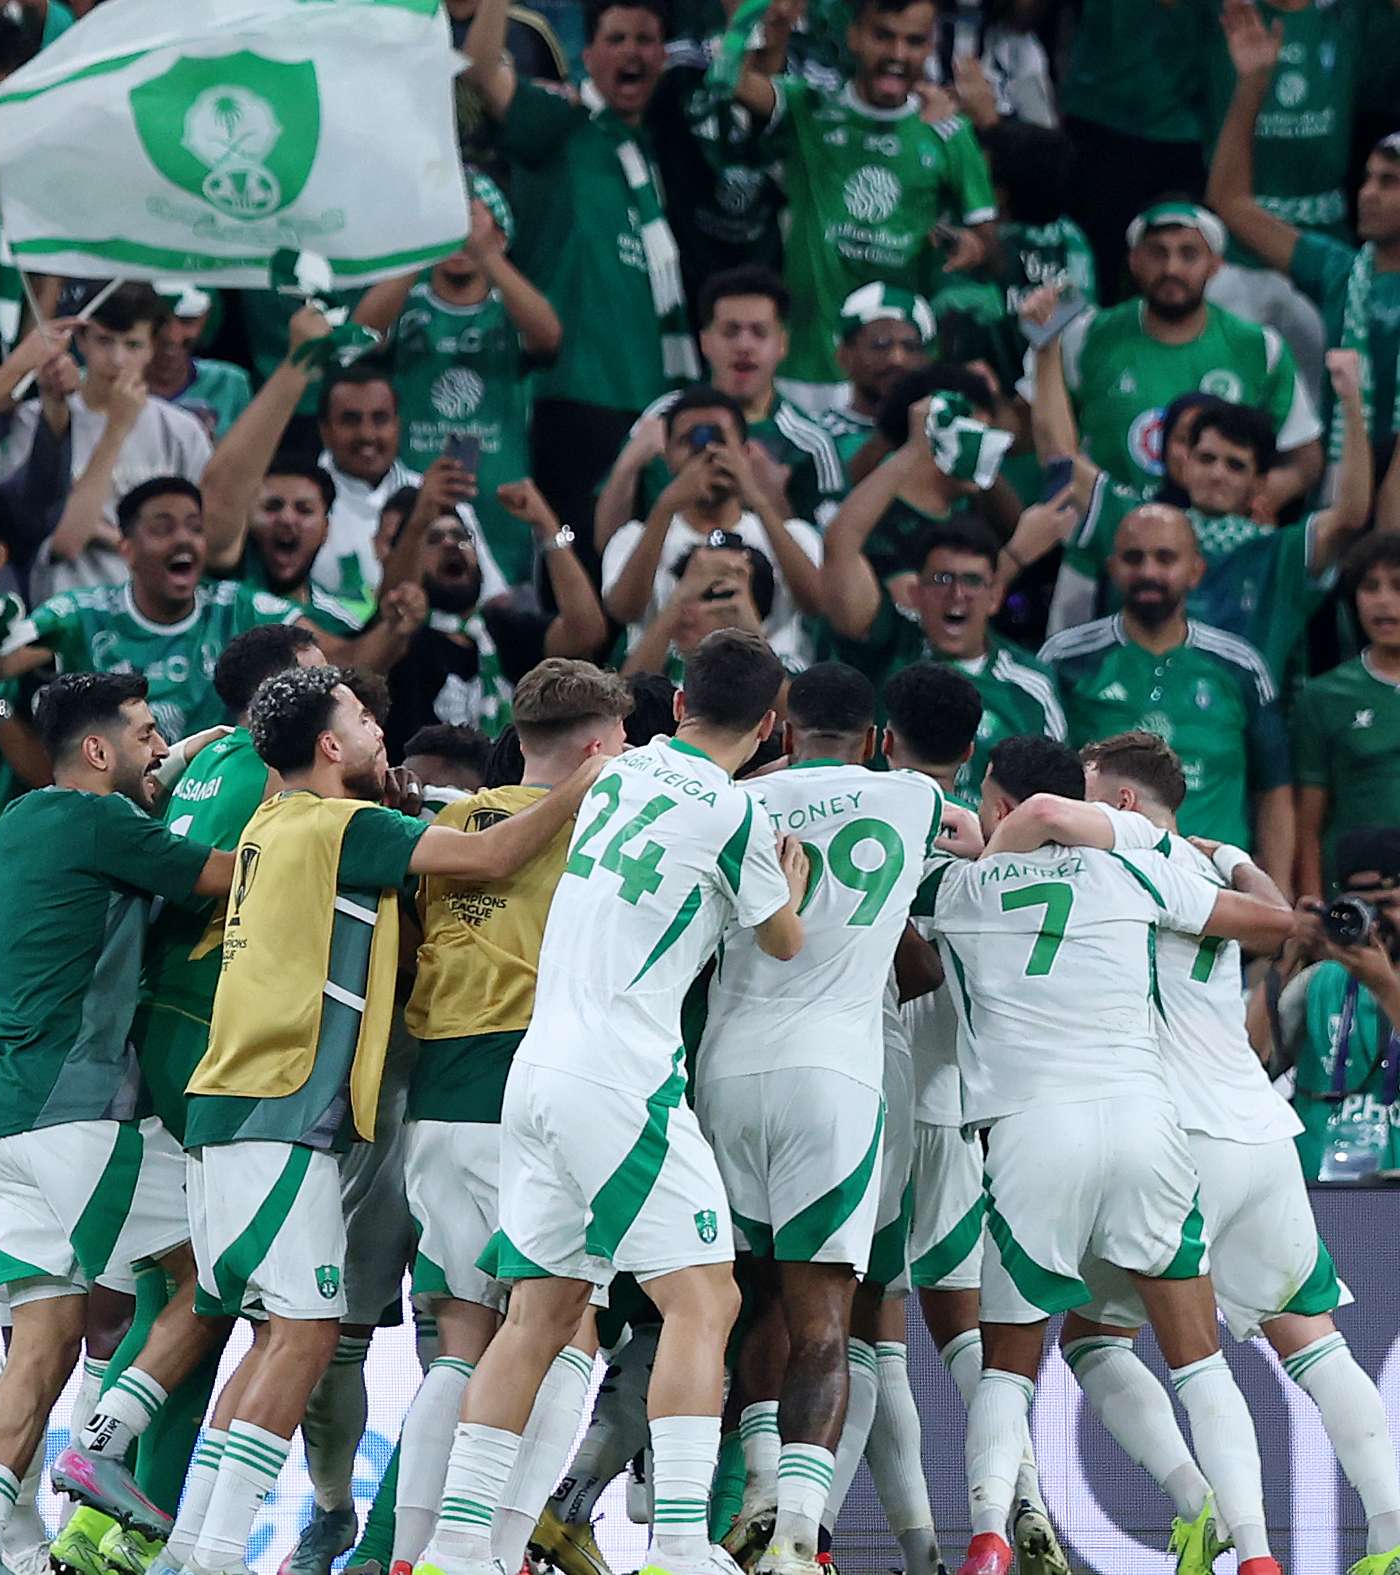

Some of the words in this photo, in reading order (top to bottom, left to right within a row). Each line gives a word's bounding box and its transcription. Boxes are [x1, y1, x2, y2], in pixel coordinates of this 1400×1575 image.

[653, 768, 718, 808] VEIGA
[769, 790, 863, 832] TONEY
[567, 772, 679, 906] 24
[1000, 881, 1075, 977] 7
